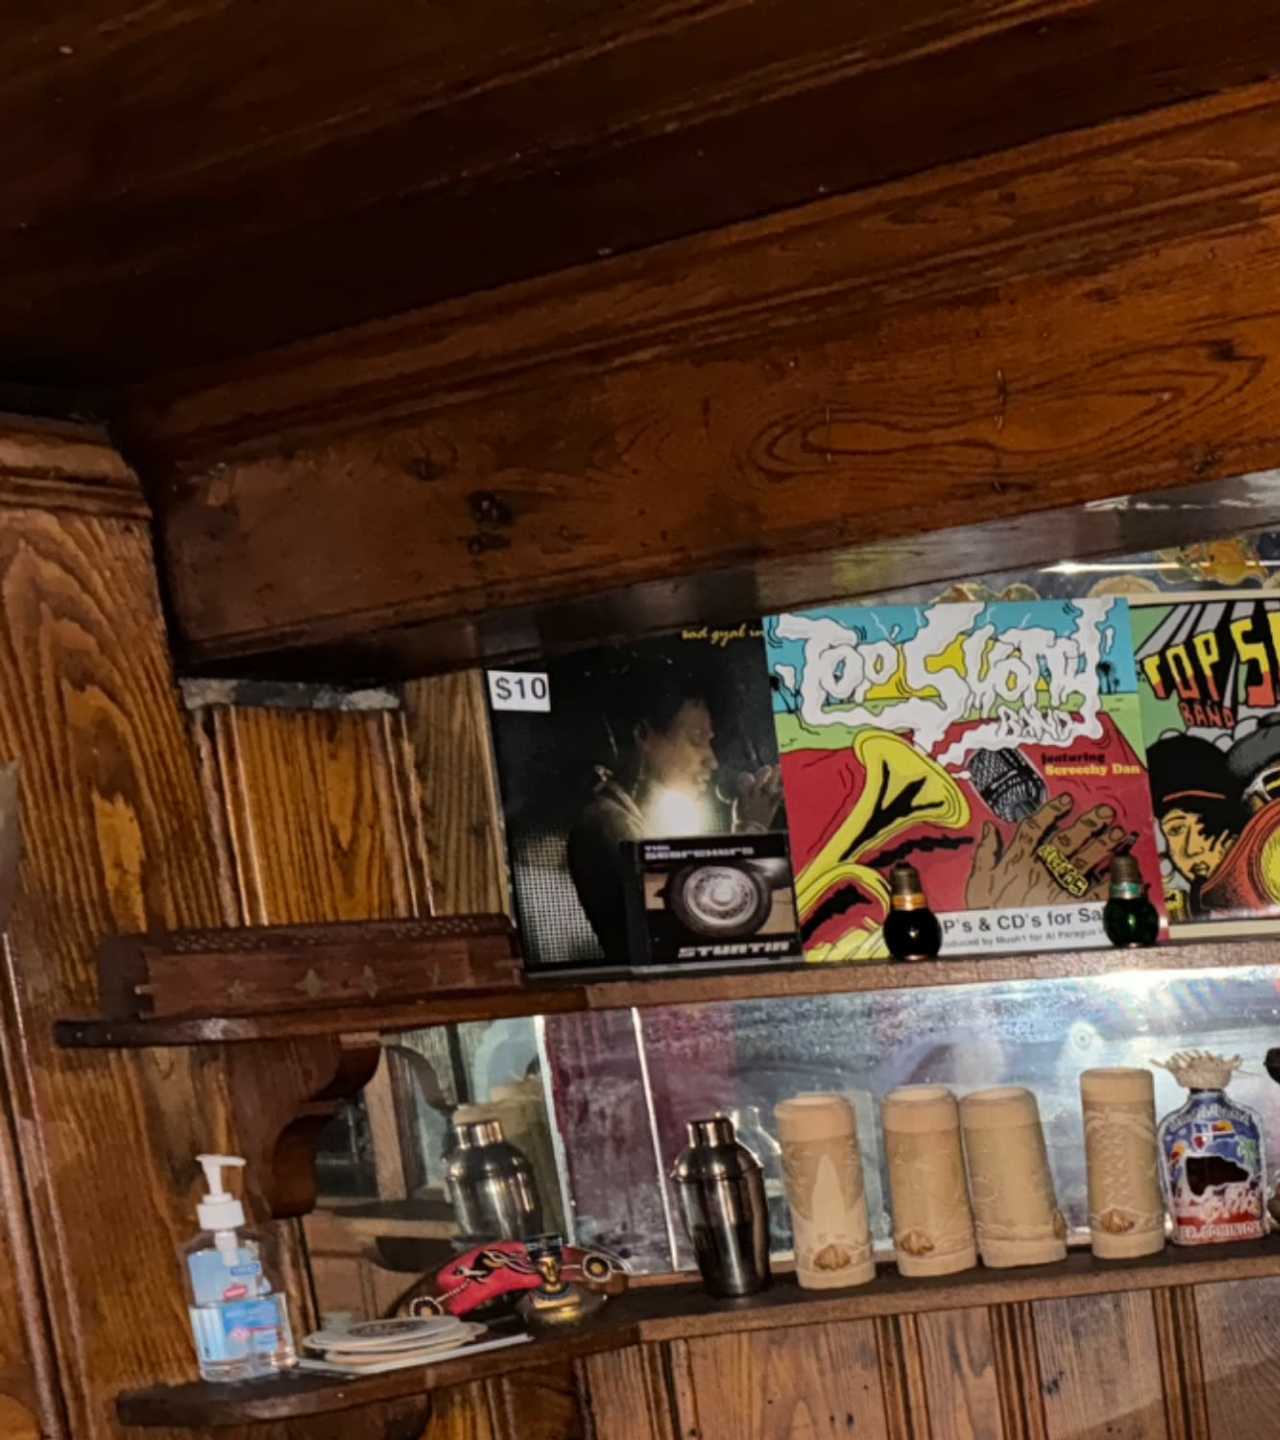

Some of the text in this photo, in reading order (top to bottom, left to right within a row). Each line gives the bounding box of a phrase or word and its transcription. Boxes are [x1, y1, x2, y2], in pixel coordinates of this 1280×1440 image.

[1141, 629, 1222, 700] TOP
[495, 676, 547, 701] $10
[1000, 706, 1078, 742] BAND
[1179, 701, 1237, 730] BAND
[1112, 762, 1142, 776] Dan
[943, 908, 1074, 934] P's & CD's for
